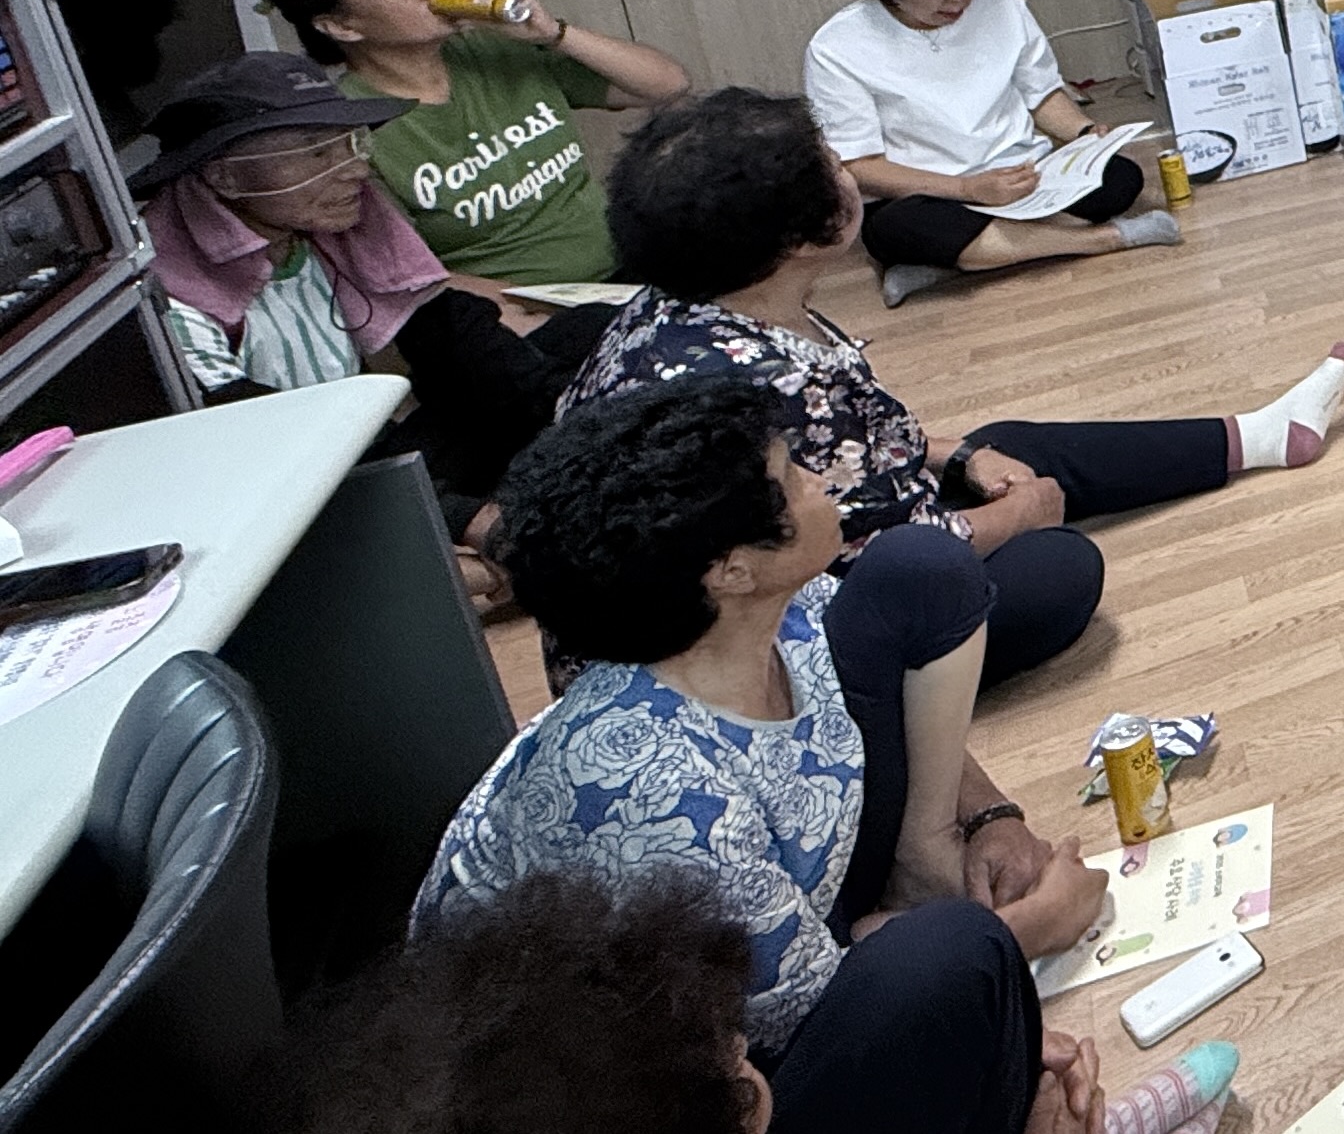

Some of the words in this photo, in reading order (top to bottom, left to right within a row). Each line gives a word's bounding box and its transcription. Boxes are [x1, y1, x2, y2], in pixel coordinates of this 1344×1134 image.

[413, 131, 509, 209] Paris
[503, 101, 565, 149] est
[454, 142, 584, 228] Magique
